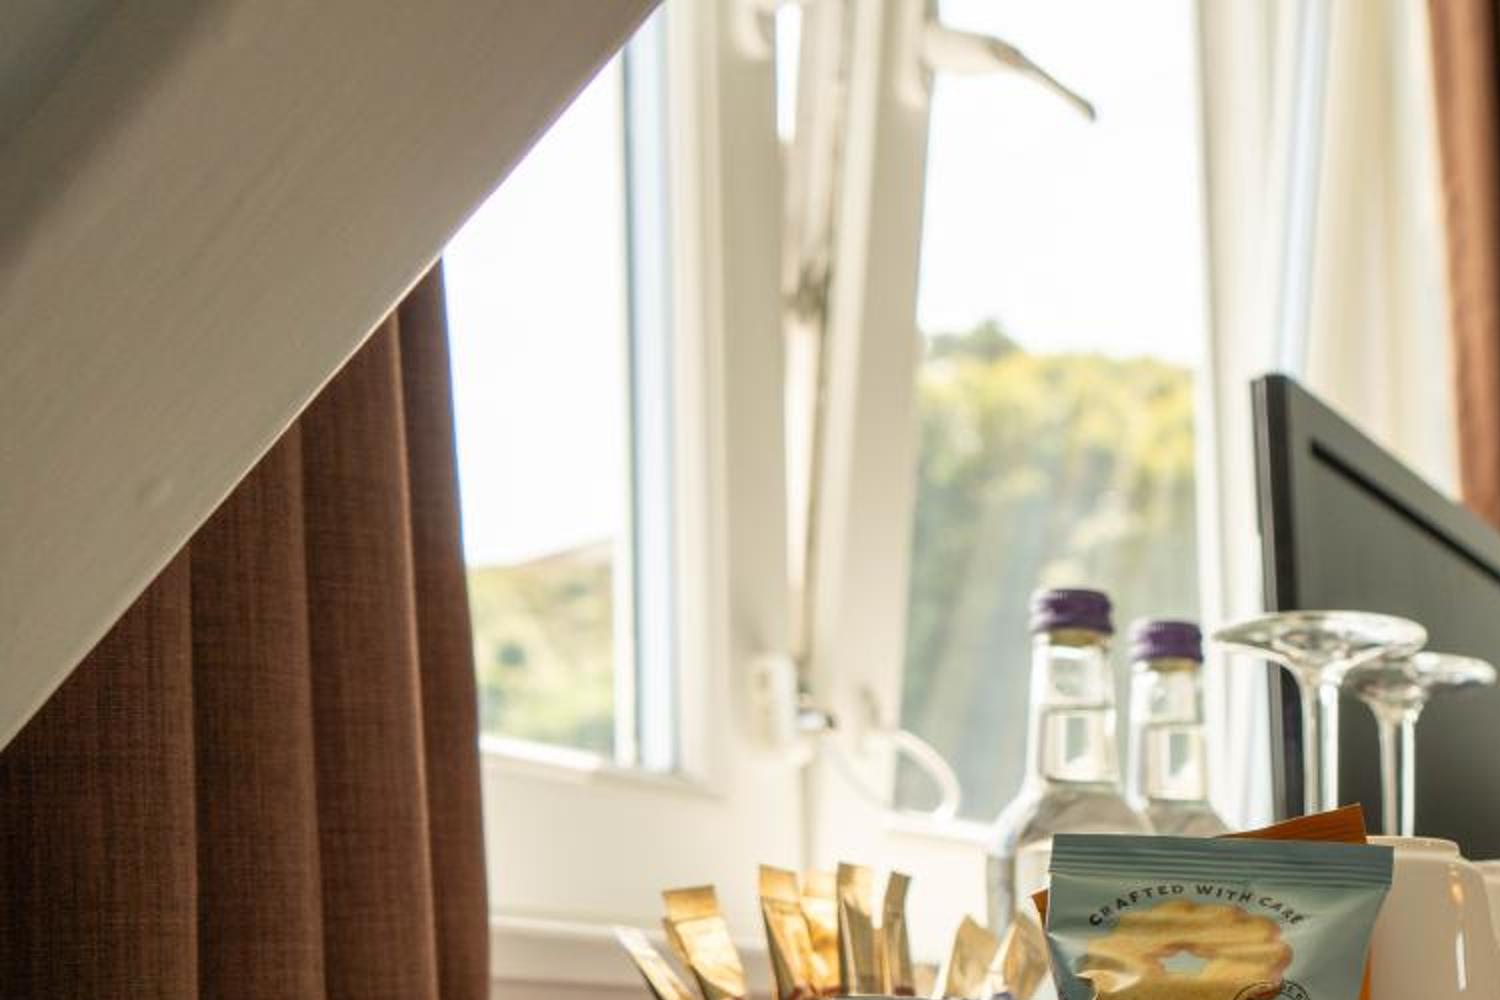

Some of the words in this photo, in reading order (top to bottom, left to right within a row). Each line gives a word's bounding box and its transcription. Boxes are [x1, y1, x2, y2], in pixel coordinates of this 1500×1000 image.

[1089, 884, 1185, 927] CRAFTED
[1195, 884, 1255, 904] WITH
[1257, 896, 1305, 925] CARE
